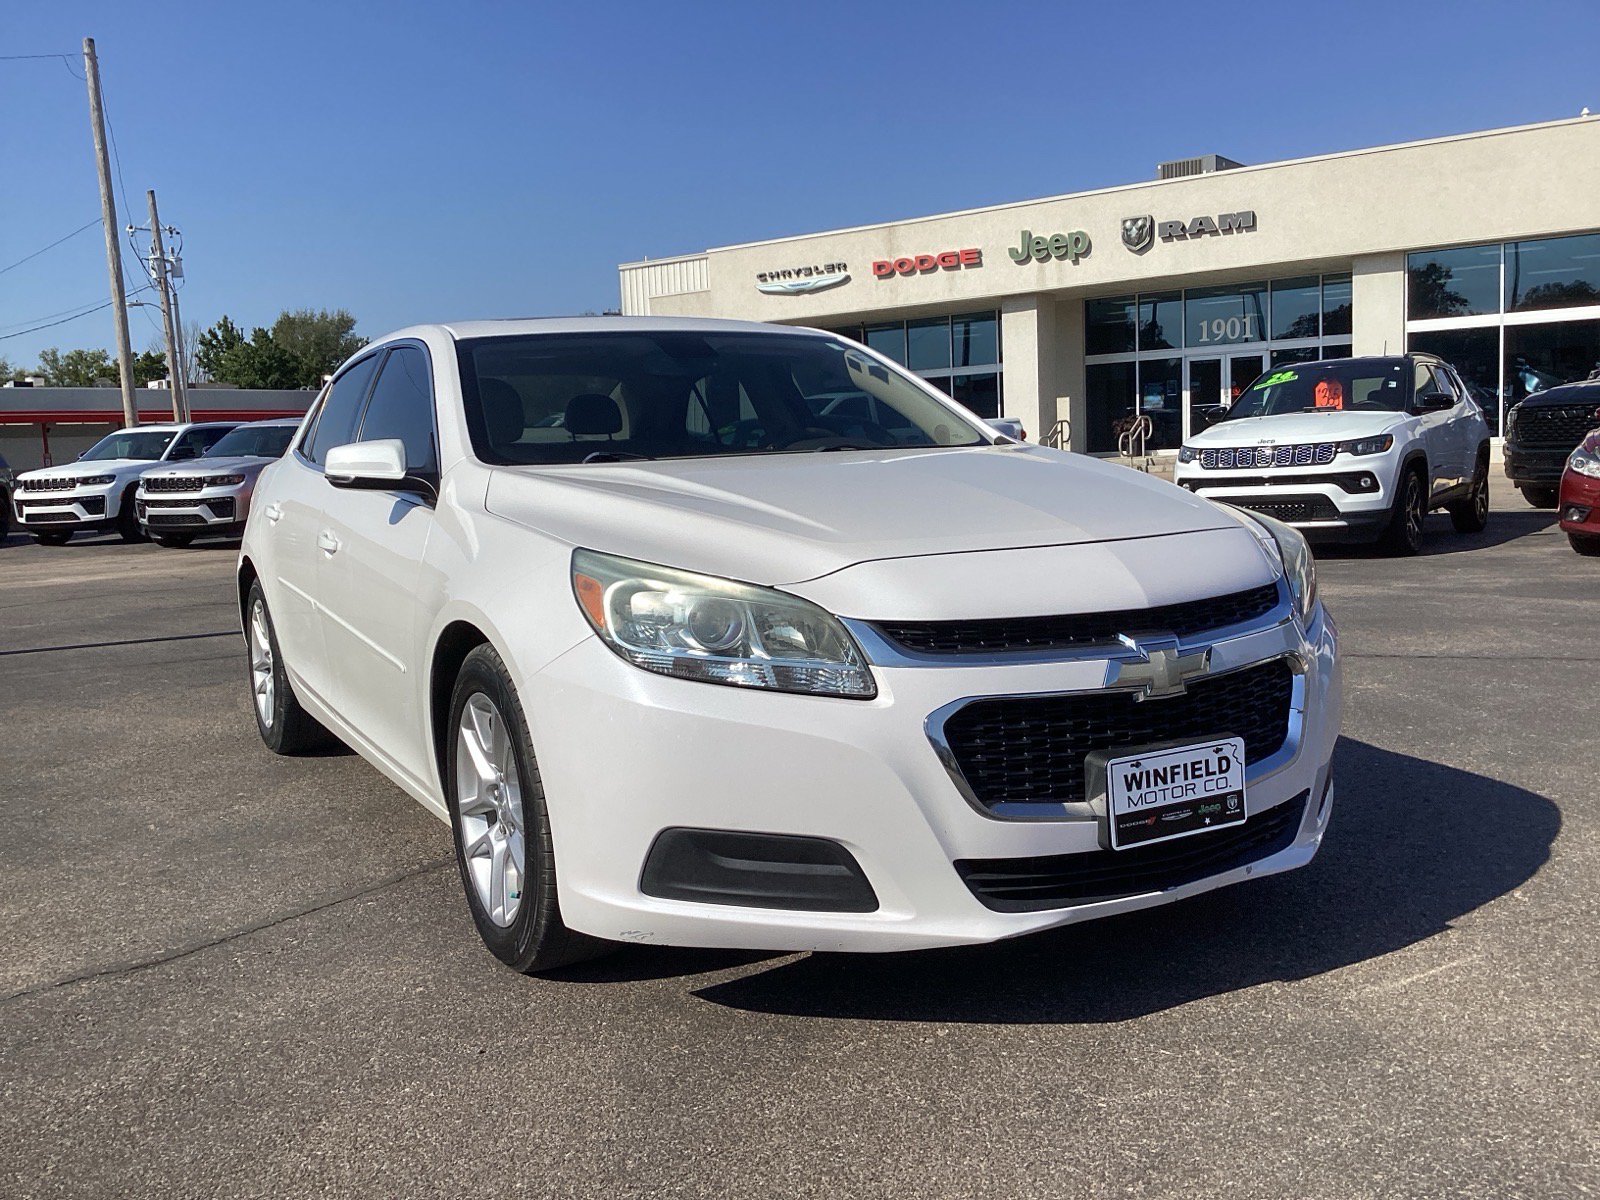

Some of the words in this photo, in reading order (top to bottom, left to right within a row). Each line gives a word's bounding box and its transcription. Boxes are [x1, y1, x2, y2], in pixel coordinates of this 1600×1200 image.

[1158, 210, 1256, 242] RAM
[1008, 229, 1092, 264] Jeep
[756, 262, 848, 283] CHRYSLER
[872, 248, 983, 279] DODGE
[1199, 316, 1253, 342] 1901
[1123, 755, 1231, 793] WINFIELD
[1127, 782, 1196, 808] MOTOR
[1204, 776, 1232, 792] CO.
